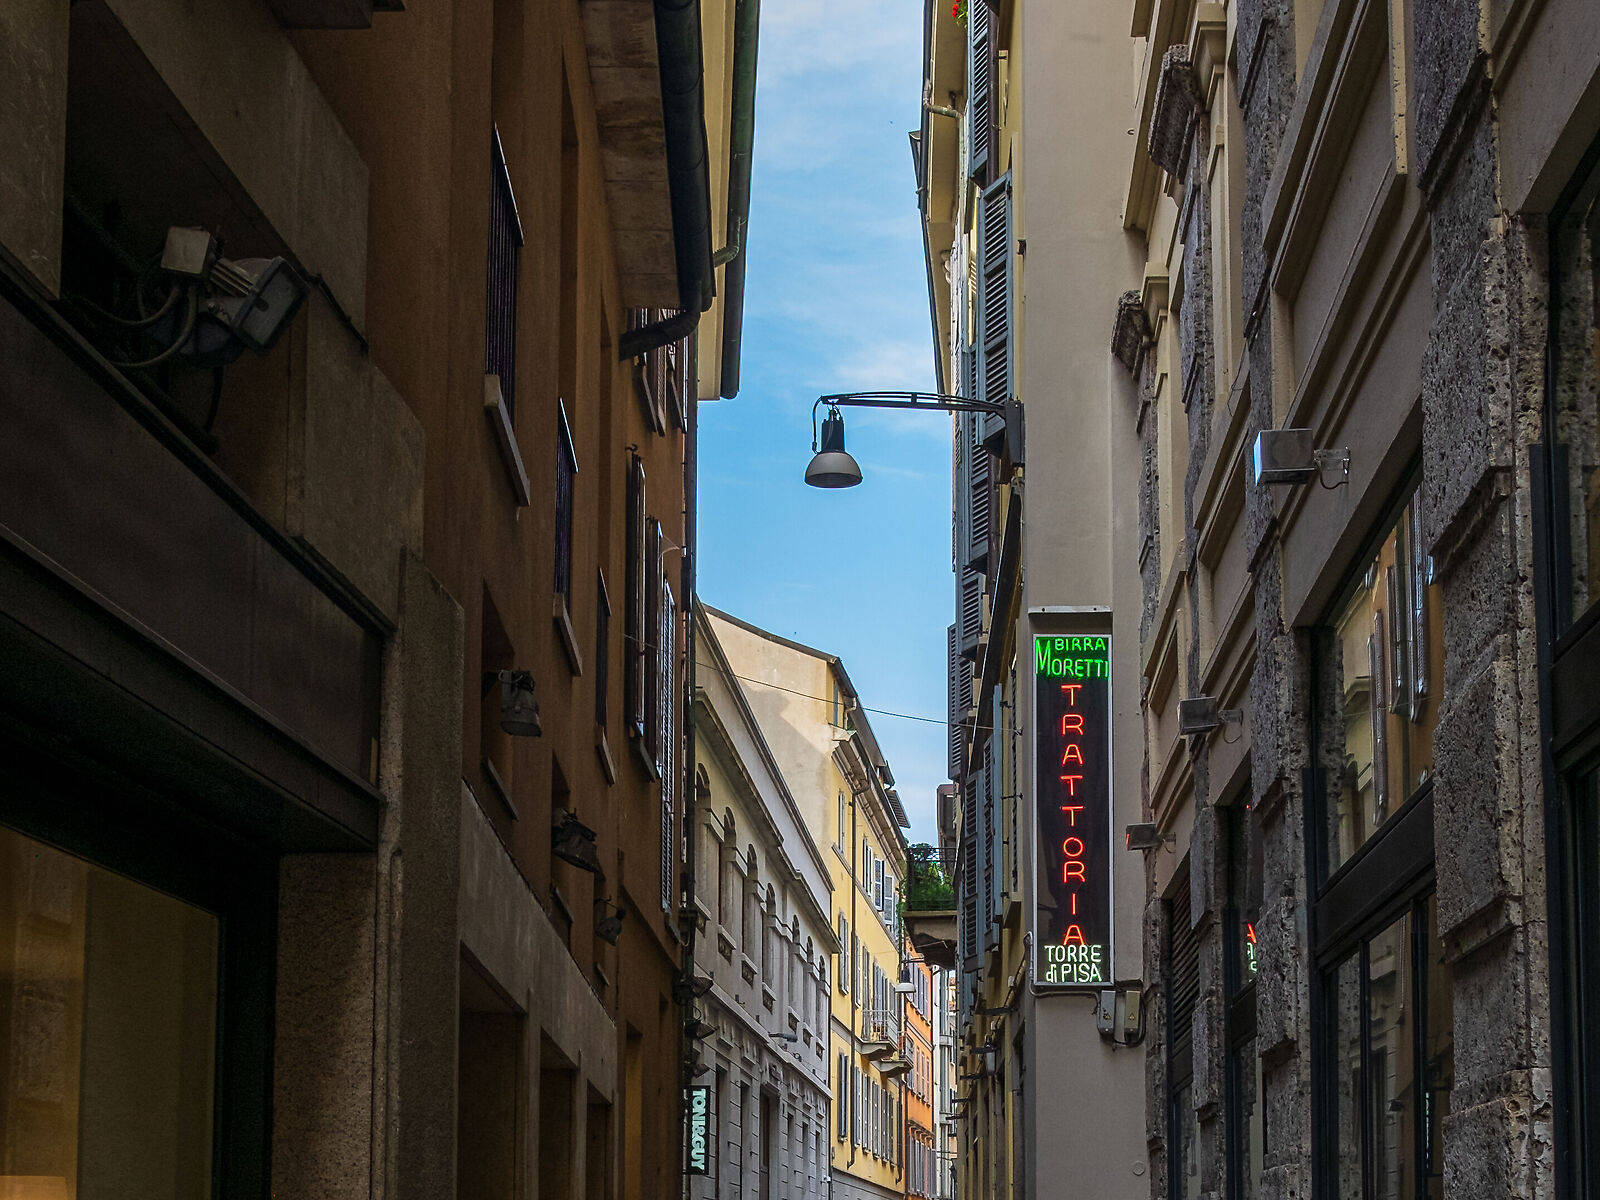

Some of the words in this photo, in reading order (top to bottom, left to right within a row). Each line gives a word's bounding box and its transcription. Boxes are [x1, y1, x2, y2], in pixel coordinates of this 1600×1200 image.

[1035, 638, 1109, 677] MORETTI
[1055, 637, 1106, 651] BIRRA
[1060, 684, 1086, 945] TRATTORIA
[1044, 944, 1102, 963] TORRE
[1046, 963, 1057, 983] di
[1061, 962, 1102, 983] PISA
[691, 1088, 706, 1170] TONI&GUY
